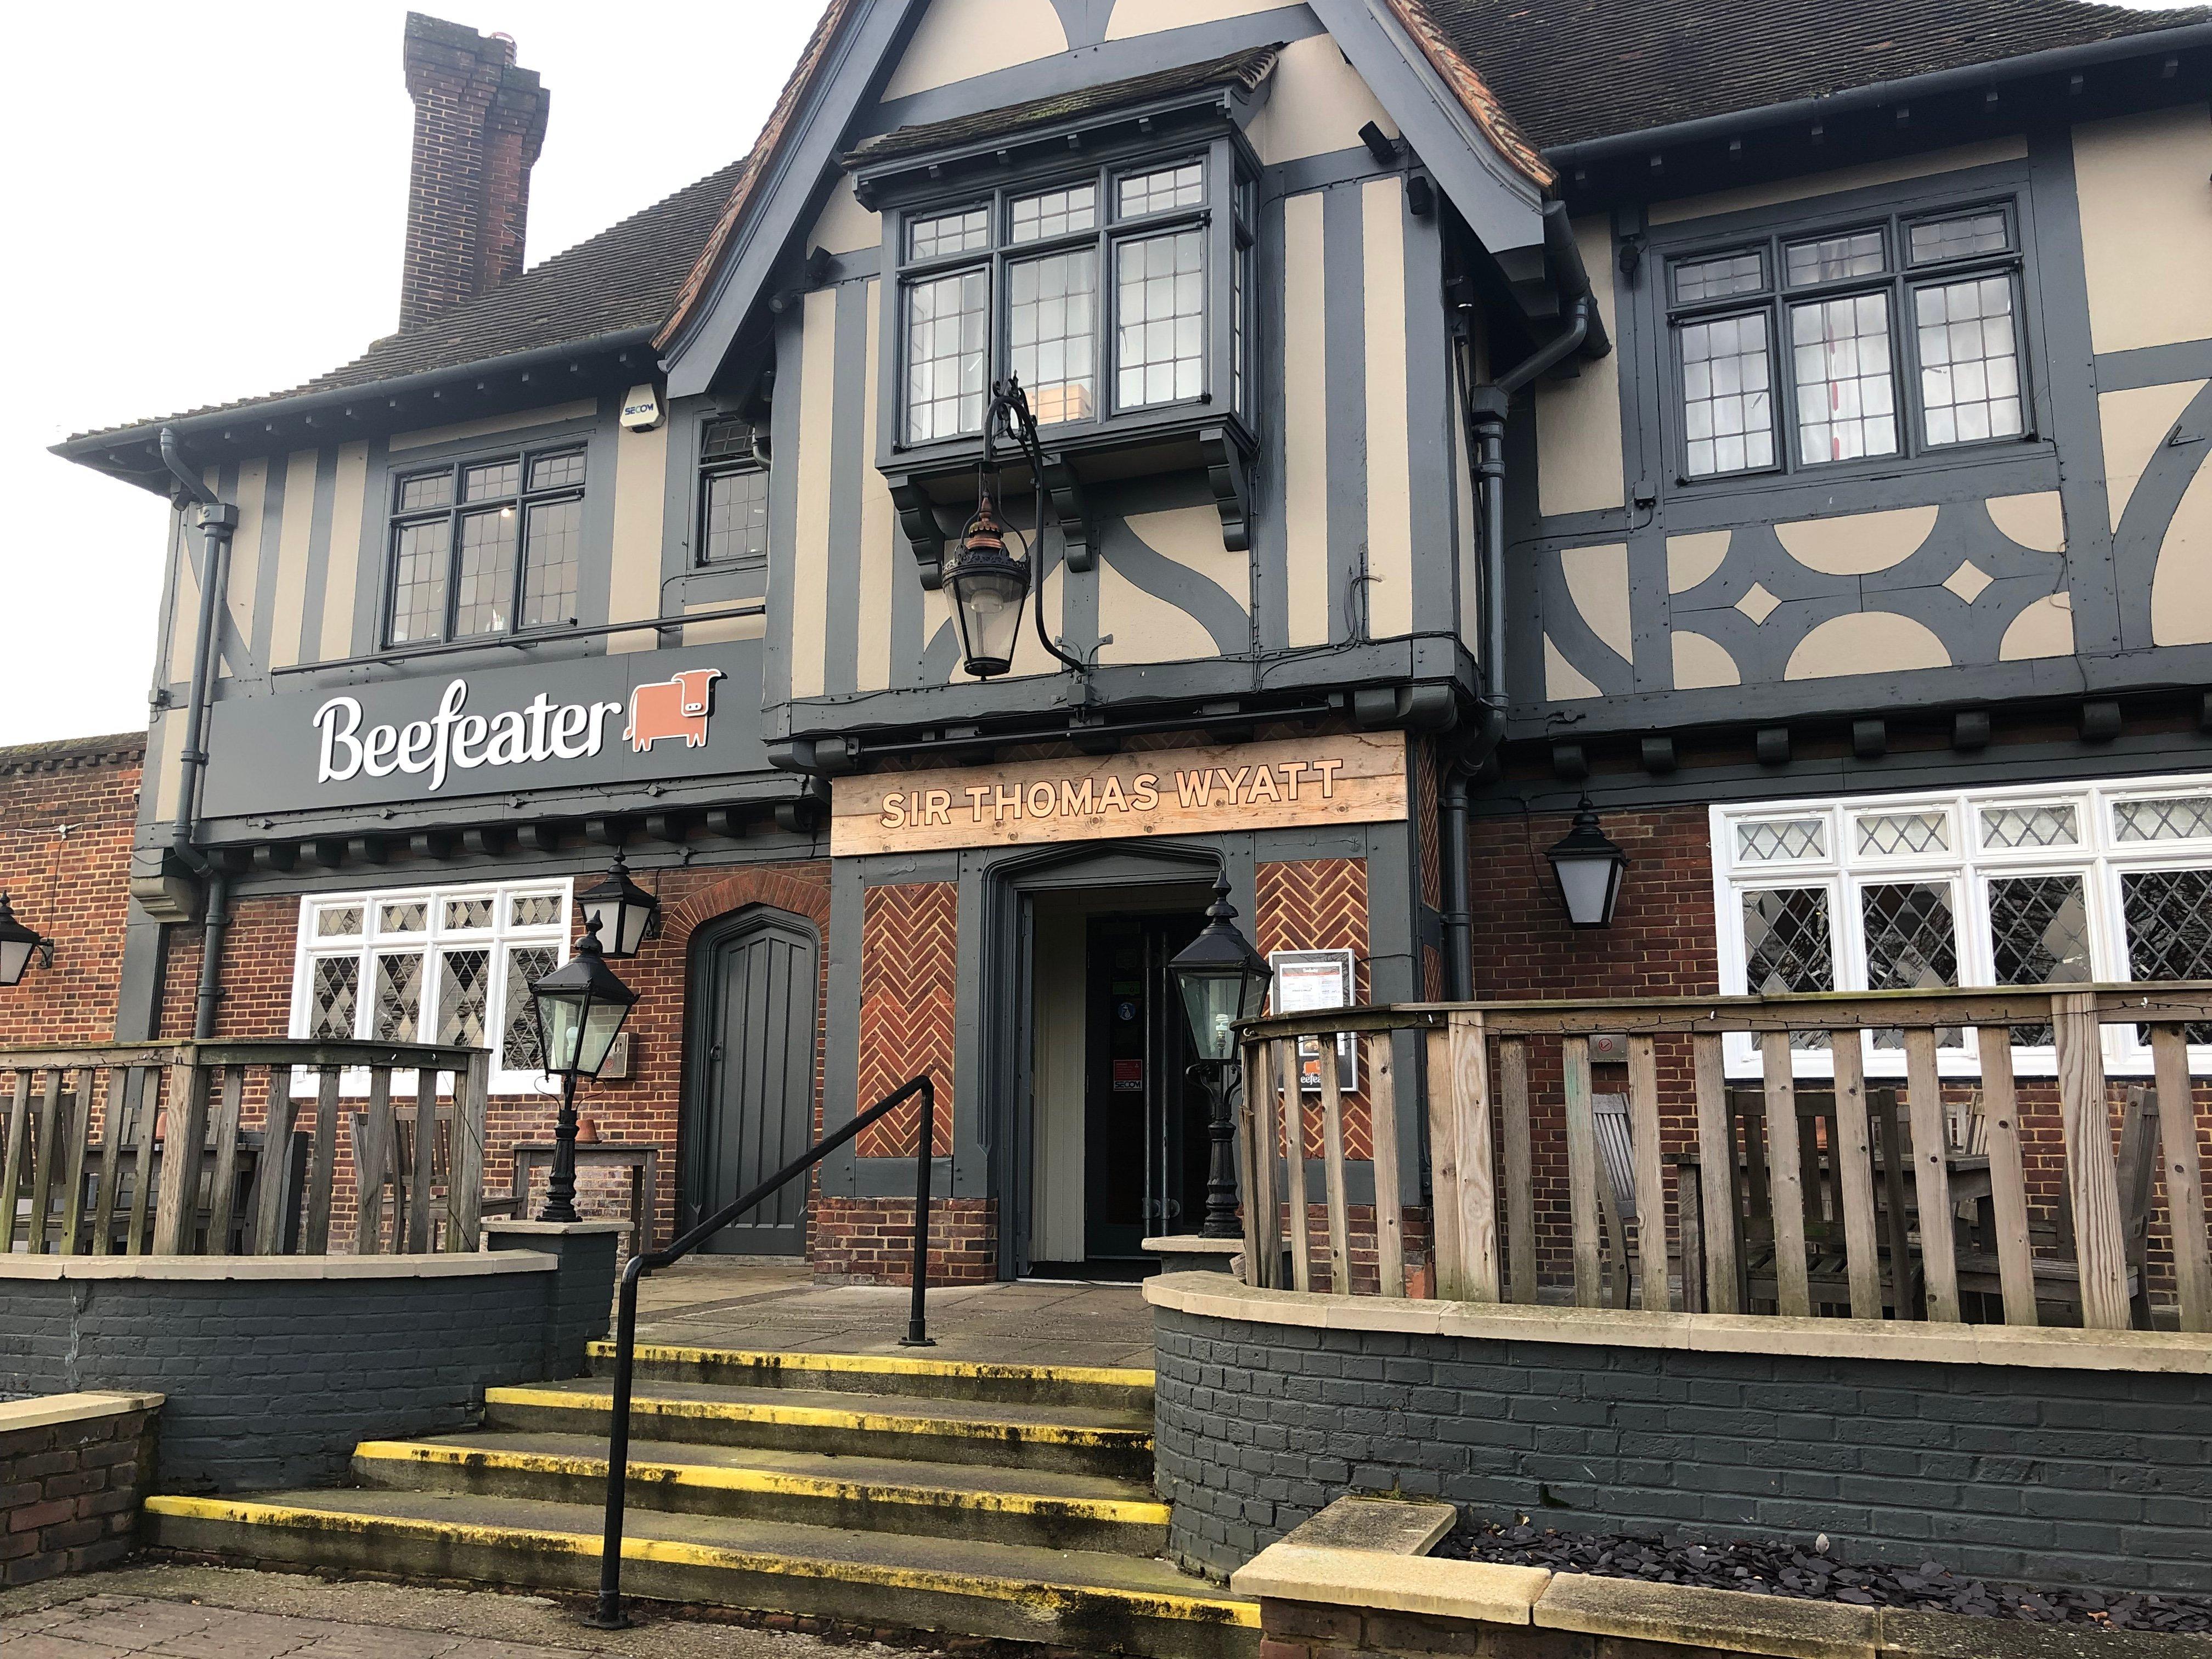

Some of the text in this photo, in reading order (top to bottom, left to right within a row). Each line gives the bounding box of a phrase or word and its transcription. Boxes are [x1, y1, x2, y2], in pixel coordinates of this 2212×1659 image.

[625, 403, 653, 415] SECOM
[313, 679, 623, 791] Beefeater
[879, 758, 1344, 828] SIR THOMAS WYATT
